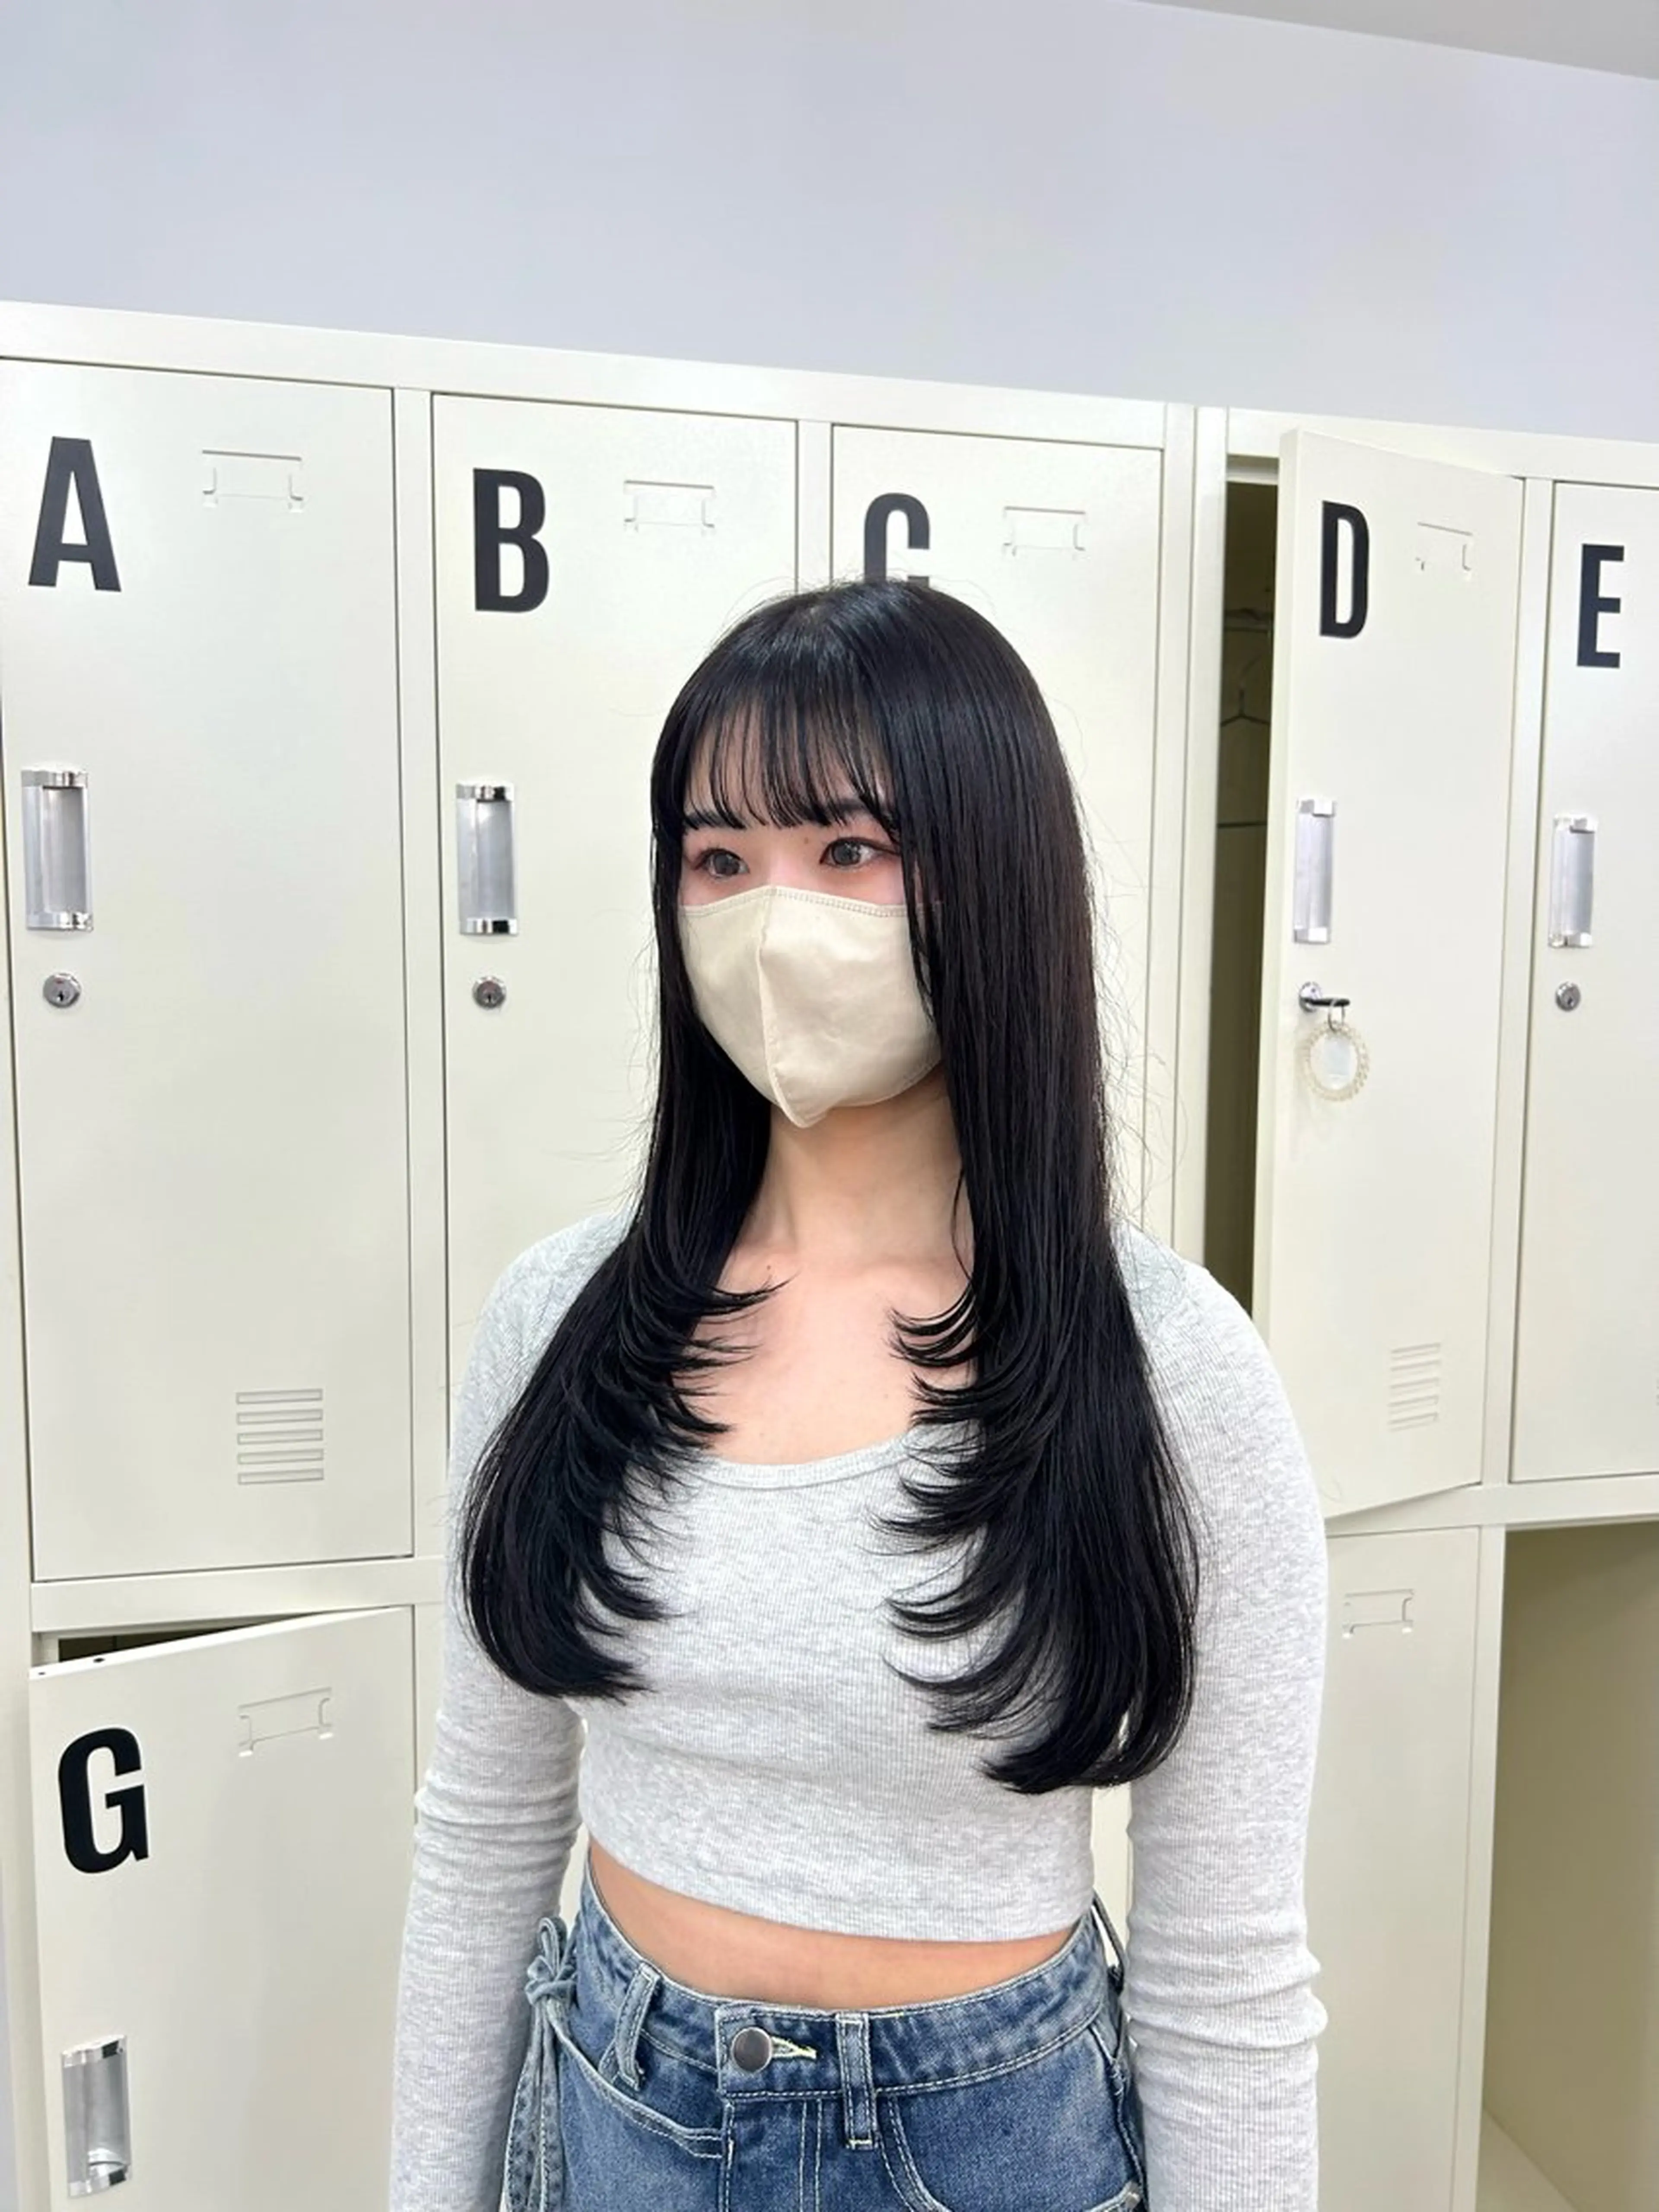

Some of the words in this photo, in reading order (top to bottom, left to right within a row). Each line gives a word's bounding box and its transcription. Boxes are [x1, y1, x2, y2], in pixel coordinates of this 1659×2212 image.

[29, 437, 121, 592] A
[474, 468, 549, 612] B
[1320, 501, 1370, 638] D
[1577, 544, 1624, 668] E
[58, 1728, 149, 1874] G
